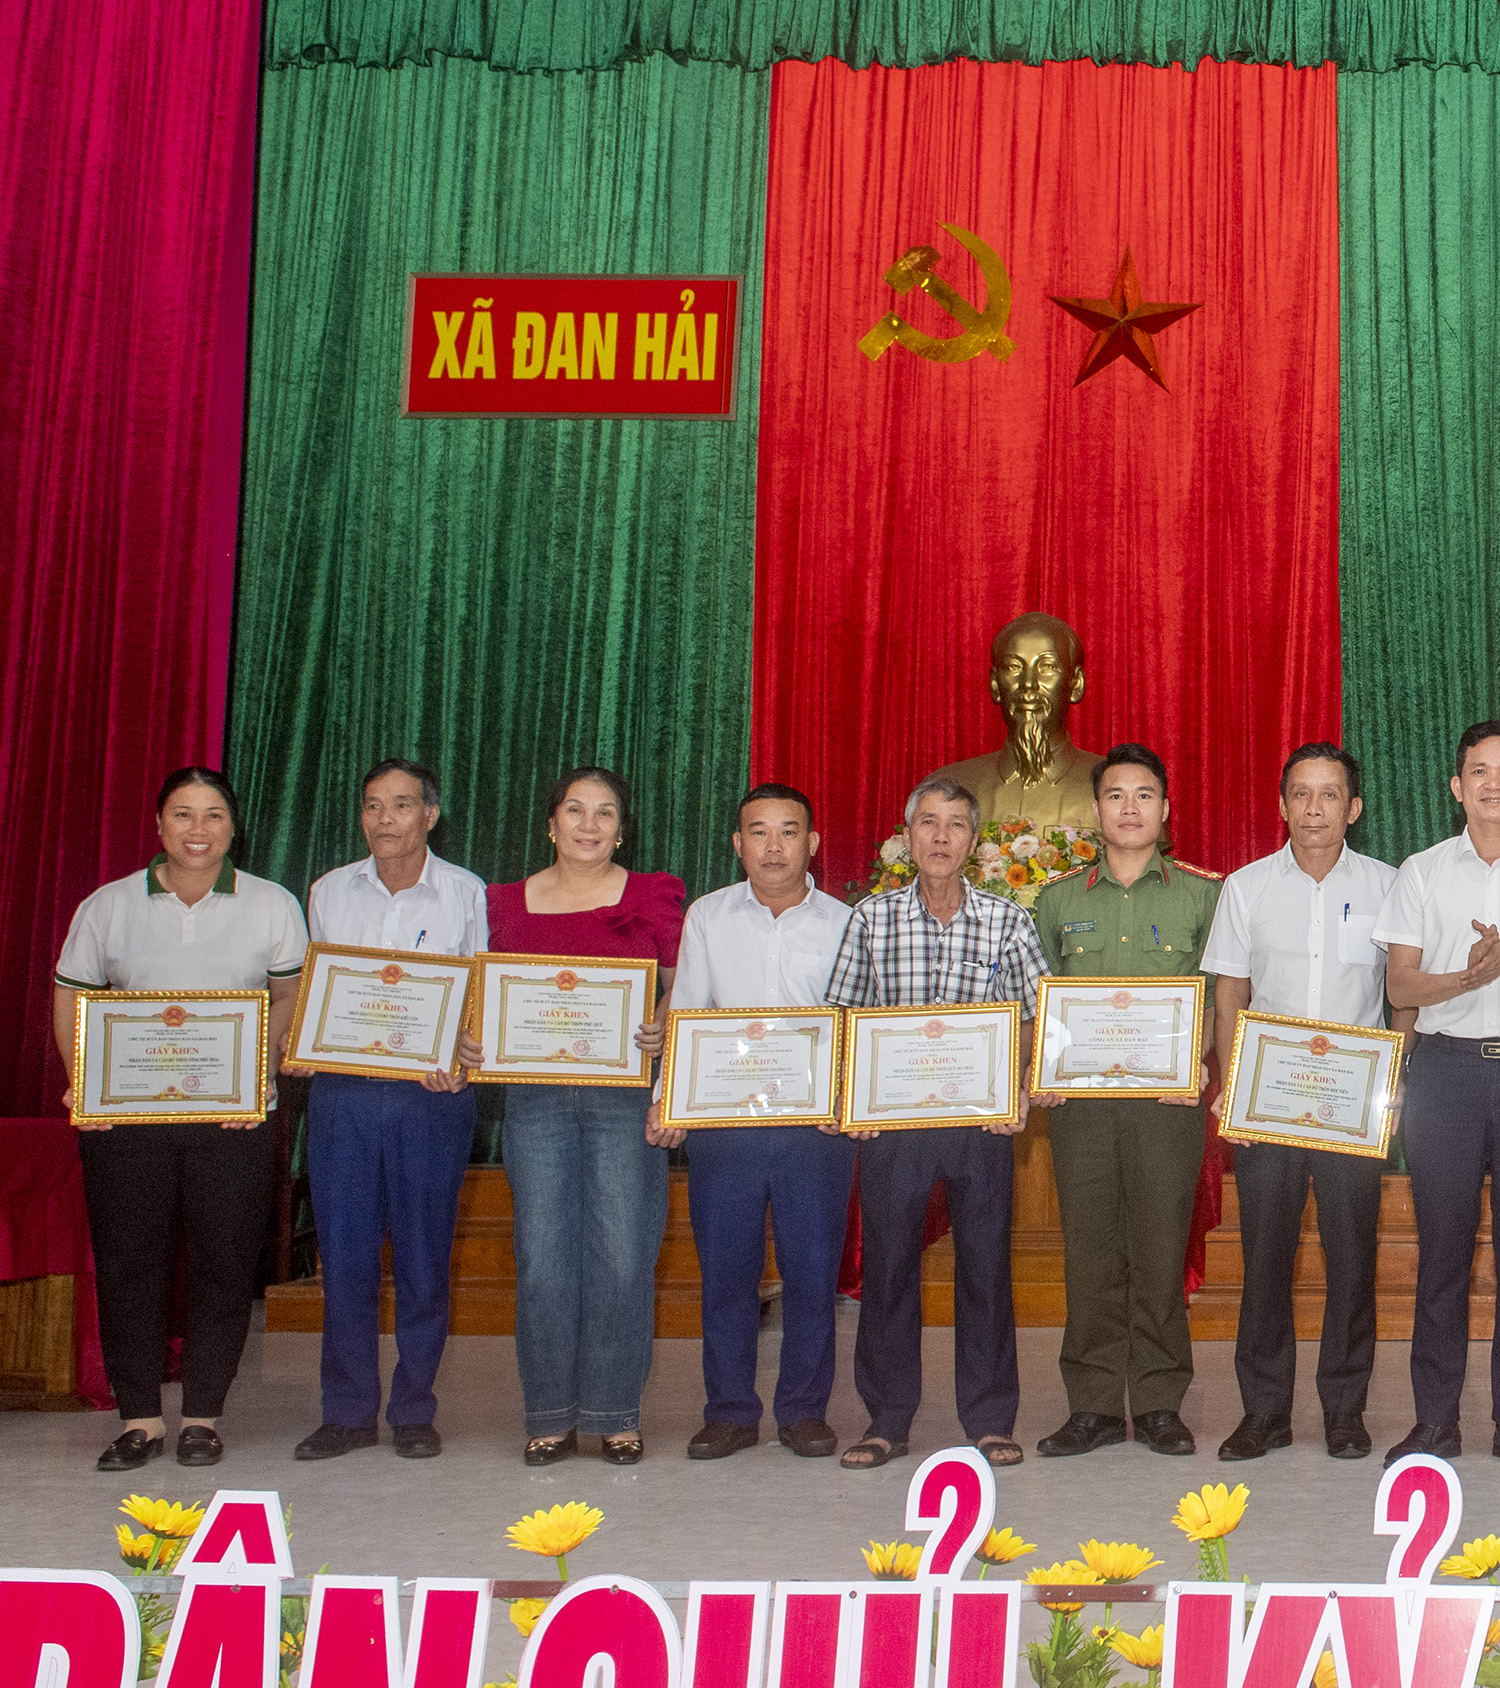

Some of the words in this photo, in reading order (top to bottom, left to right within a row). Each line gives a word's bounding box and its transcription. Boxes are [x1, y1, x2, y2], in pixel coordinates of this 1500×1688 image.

[428, 297, 496, 379] XÃ
[512, 311, 618, 380] ĐAN
[633, 288, 718, 381] HẢI
[384, 1004, 408, 1012] KHEN
[172, 1047, 199, 1055] KHEN
[1313, 1075, 1337, 1084] KHEN
